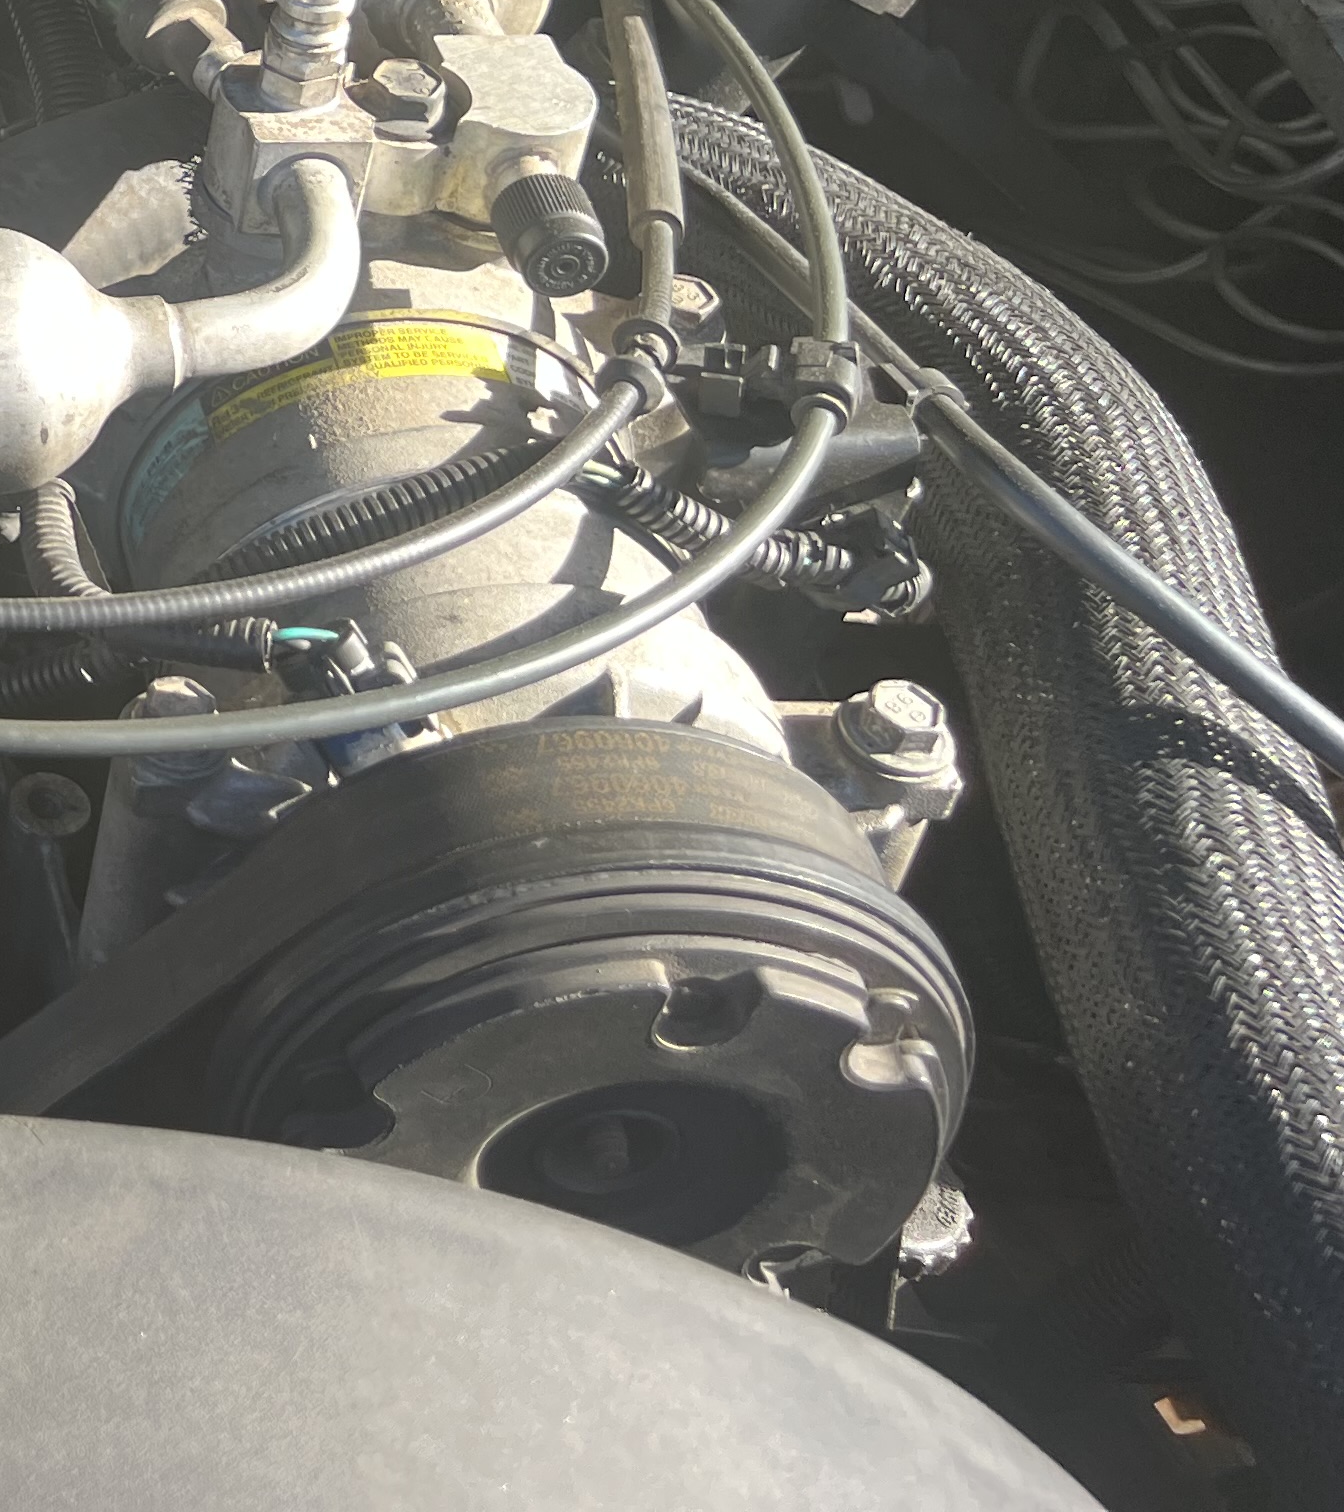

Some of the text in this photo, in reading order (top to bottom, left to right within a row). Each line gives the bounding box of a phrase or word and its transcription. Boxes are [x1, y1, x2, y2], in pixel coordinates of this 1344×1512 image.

[334, 328, 447, 343] IMPROPER SERVICE
[398, 335, 421, 343] MAY
[424, 335, 464, 345] CAUSE
[366, 358, 428, 371] QUALIFIED
